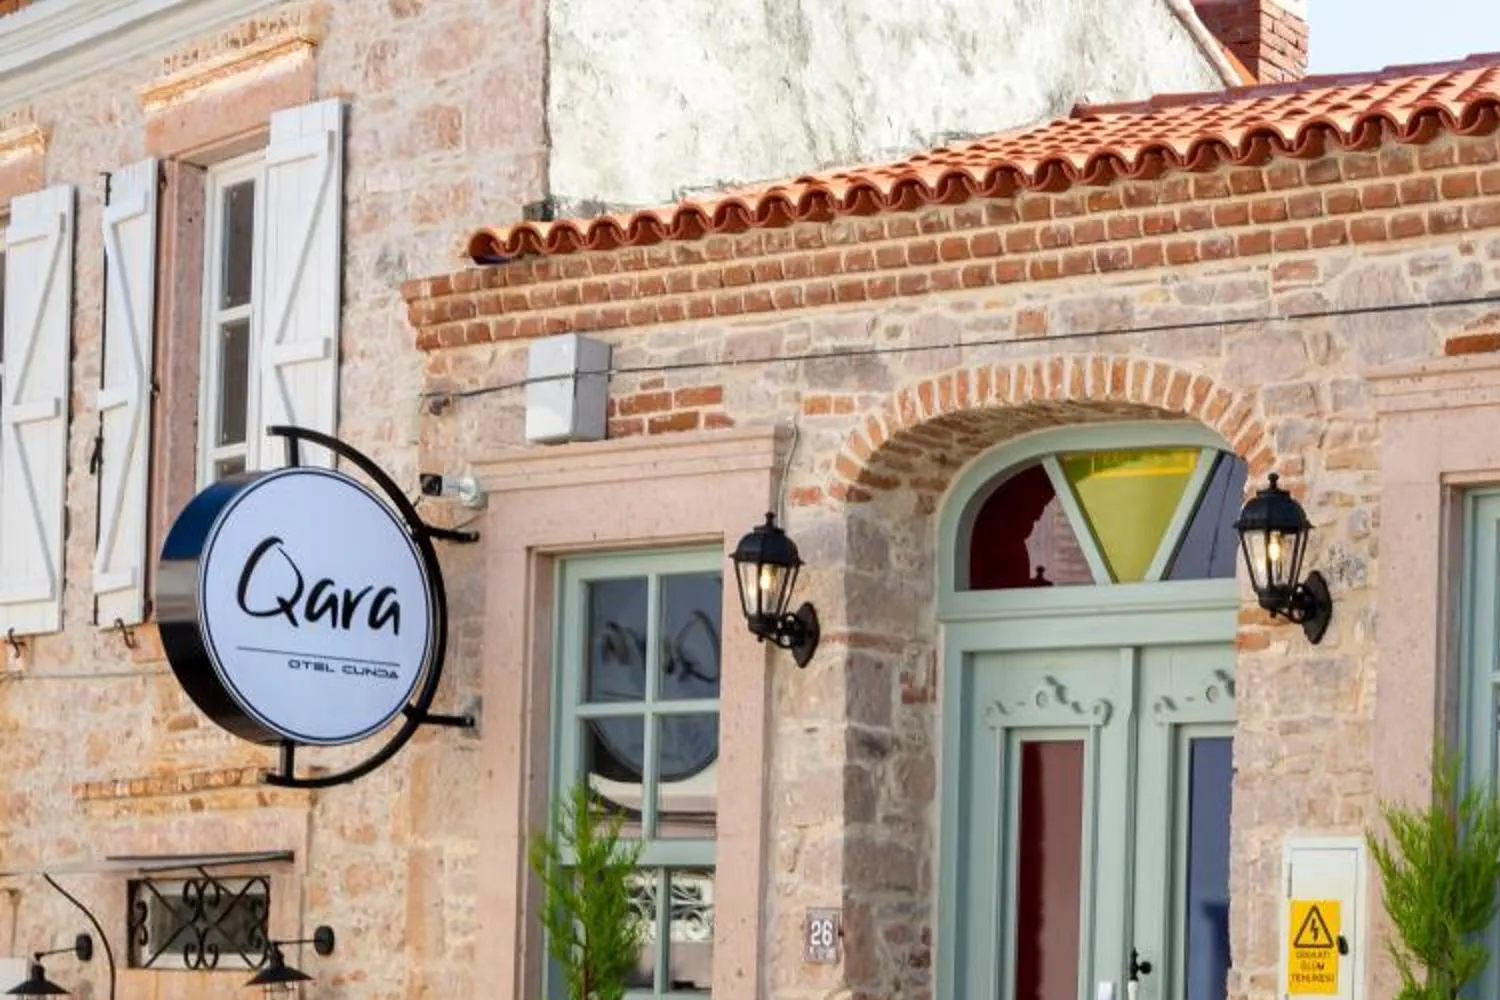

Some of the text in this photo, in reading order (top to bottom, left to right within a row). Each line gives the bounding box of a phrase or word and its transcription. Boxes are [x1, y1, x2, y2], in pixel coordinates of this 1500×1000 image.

[237, 536, 399, 636] Qara
[288, 659, 399, 679] OTEL CUNDA
[811, 920, 833, 946] 26
